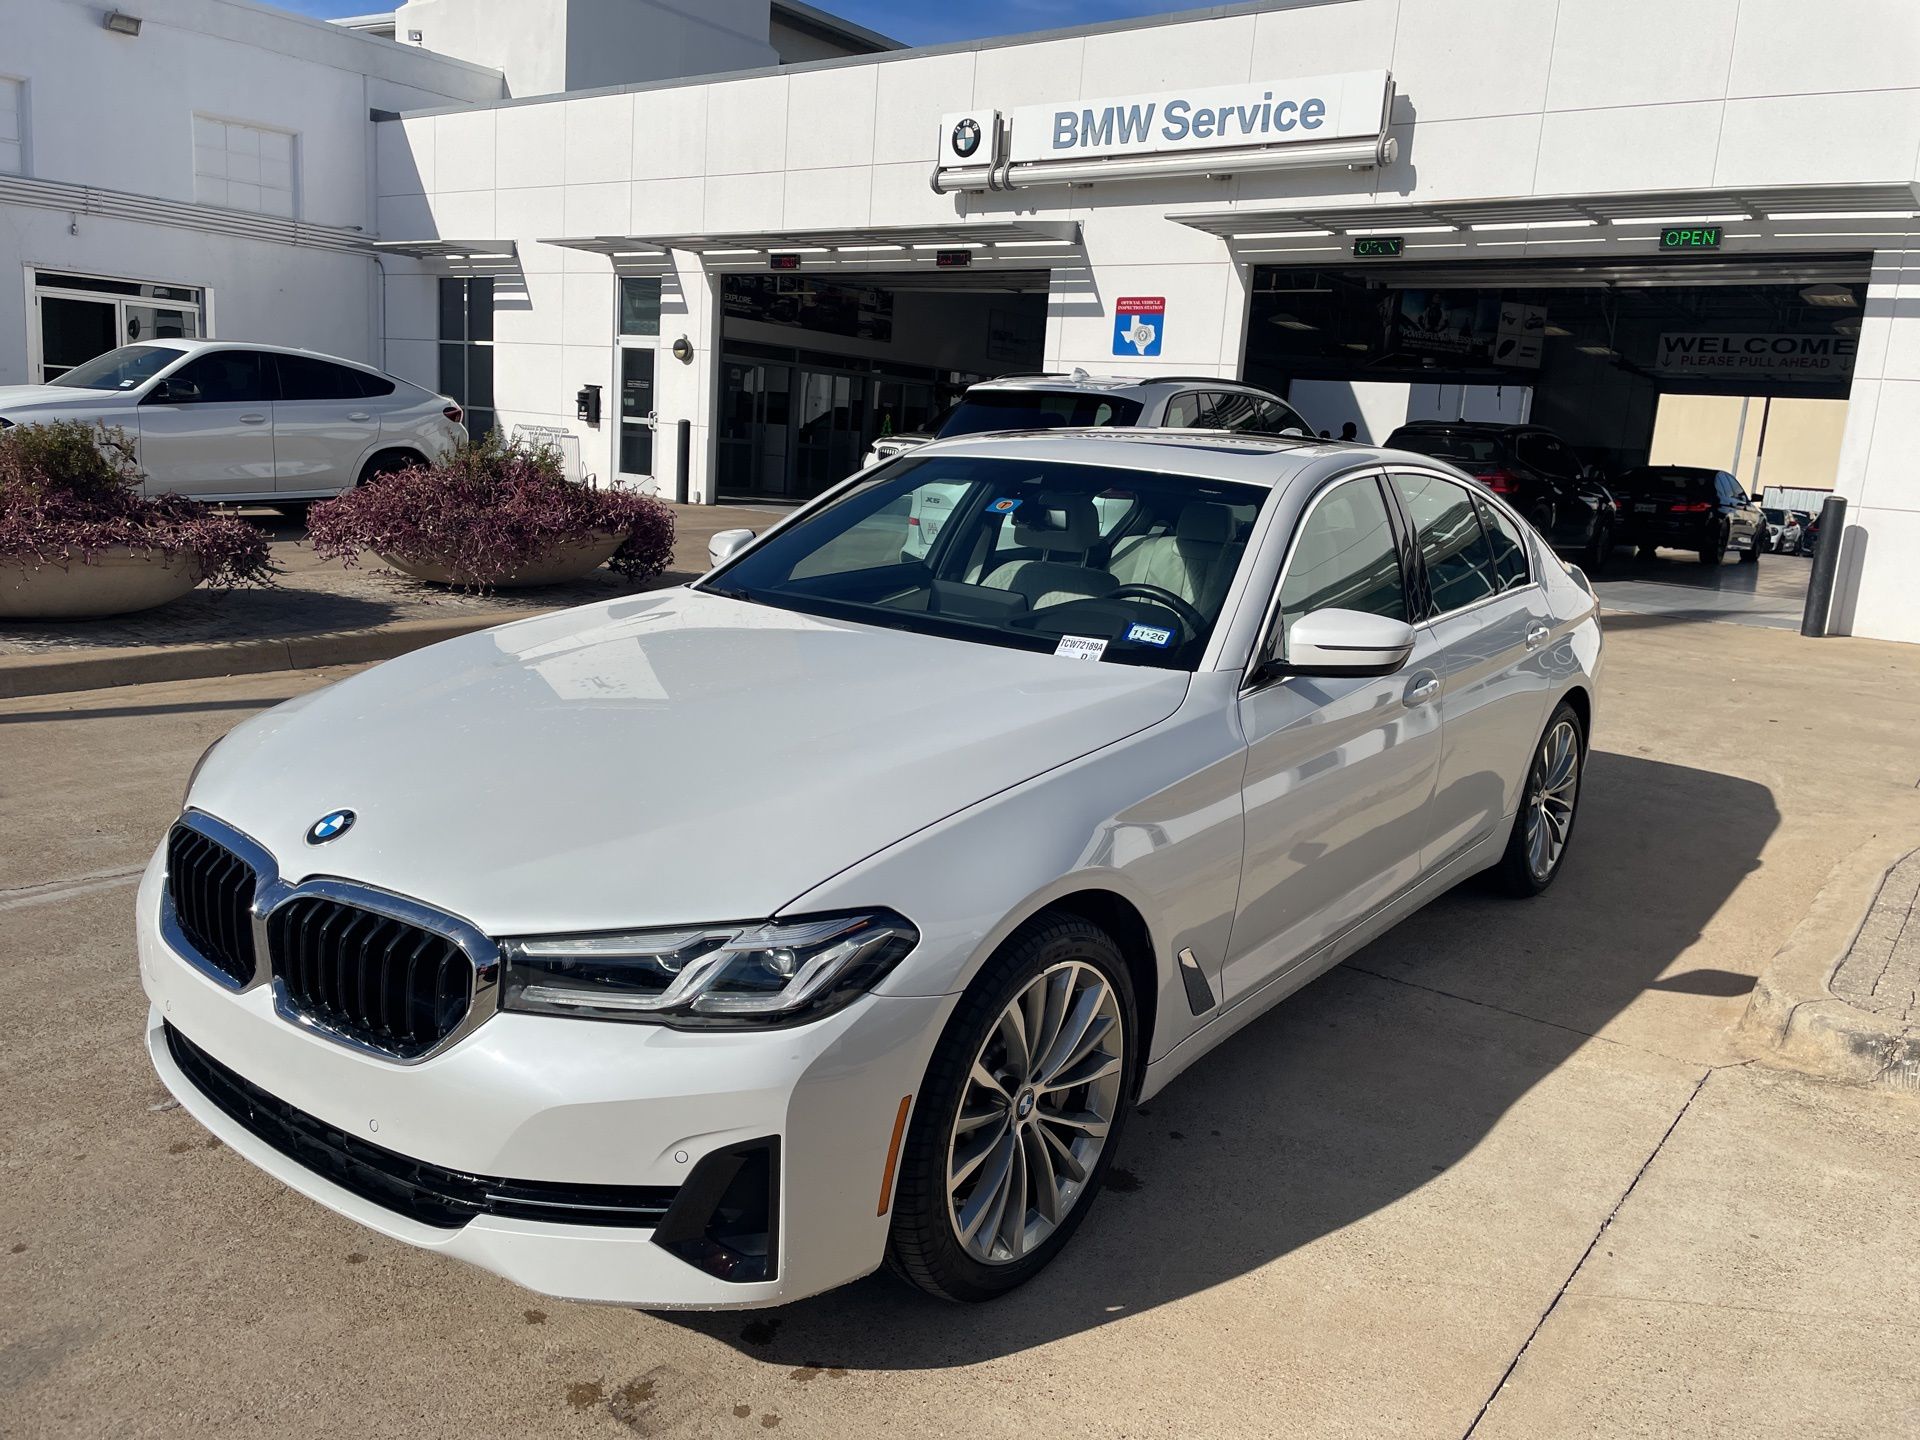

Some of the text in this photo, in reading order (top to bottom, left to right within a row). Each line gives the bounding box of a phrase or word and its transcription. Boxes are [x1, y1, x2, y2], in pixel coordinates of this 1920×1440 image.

[1052, 91, 1326, 150] BMW Service
[1665, 230, 1716, 246] OPEN
[1663, 336, 1857, 356] WELCOME
[1680, 355, 1830, 369] PLEASE PULL AHEAD
[1060, 638, 1104, 652] TCW72189A
